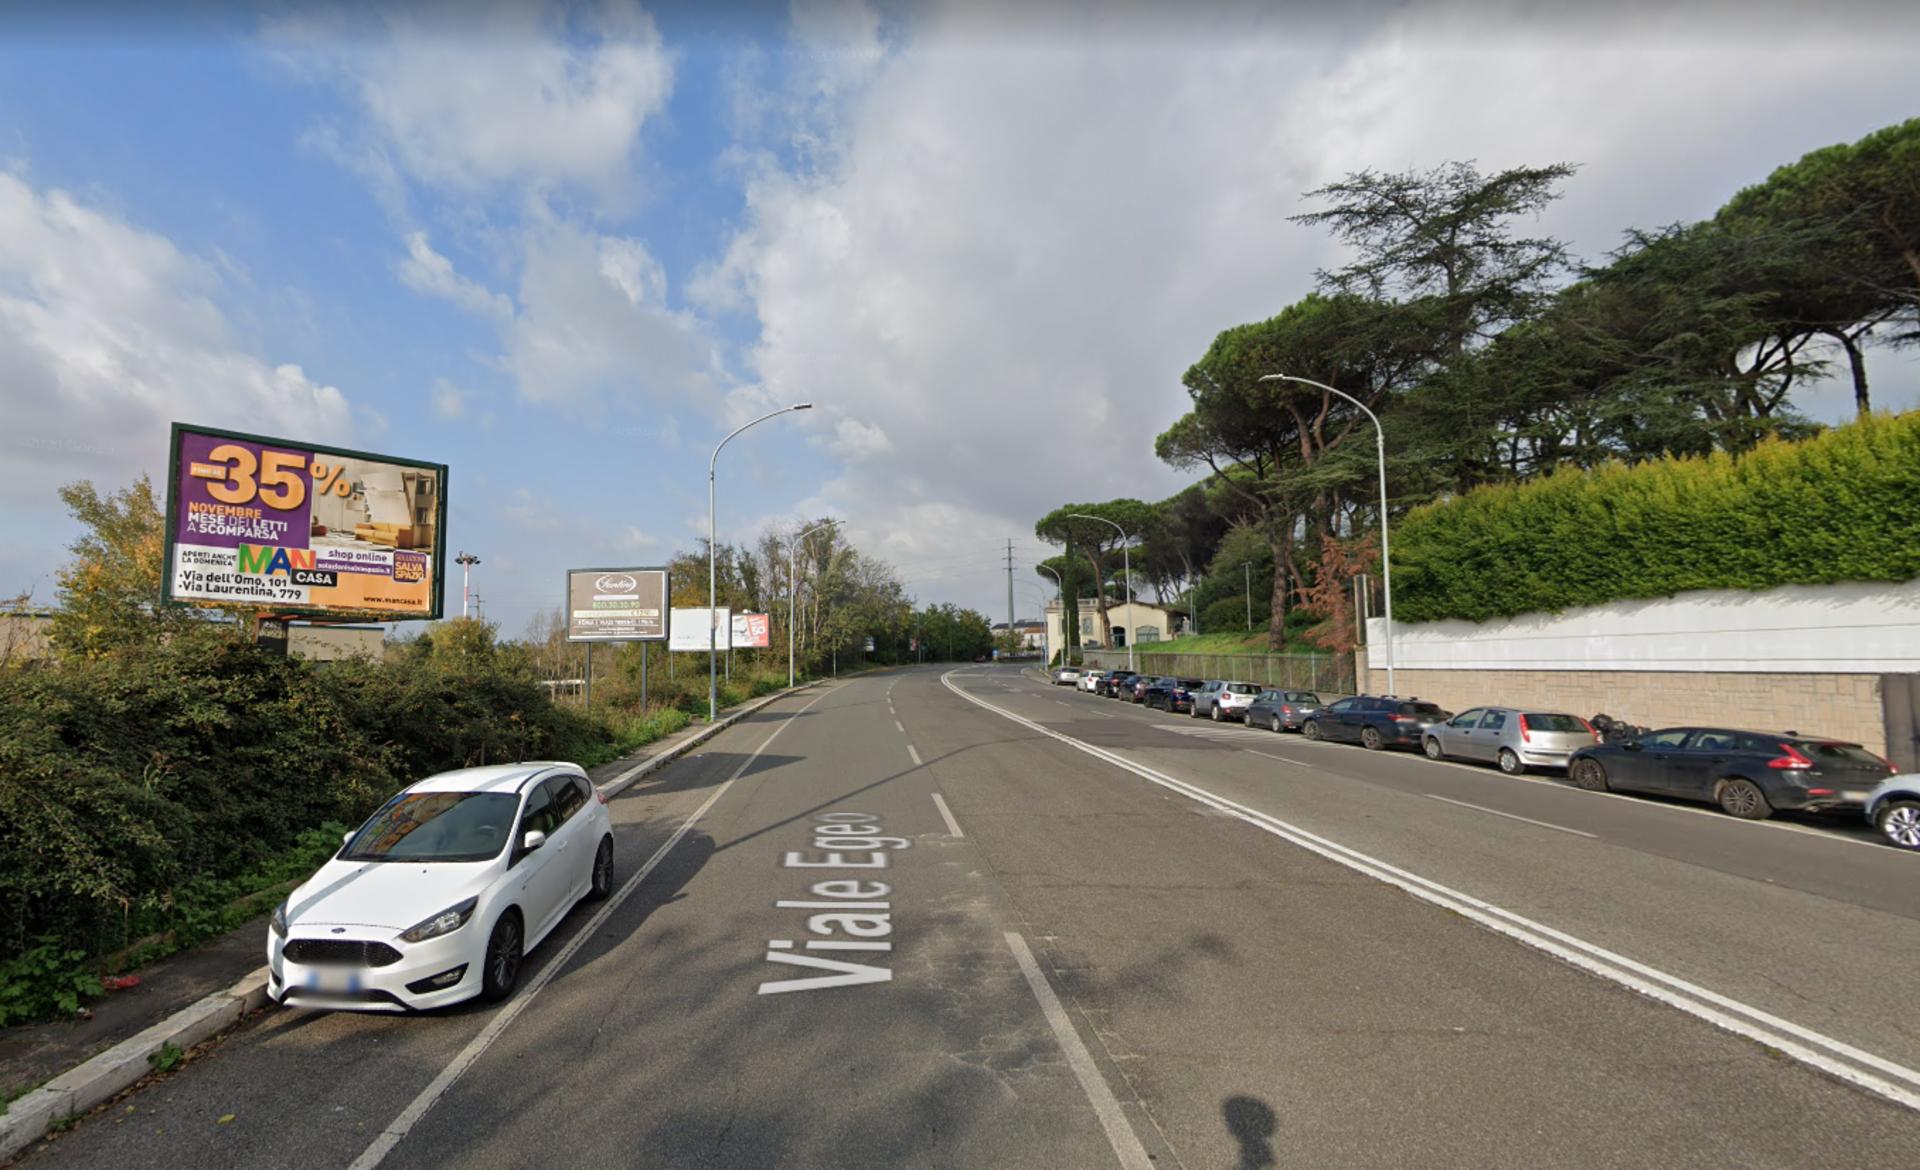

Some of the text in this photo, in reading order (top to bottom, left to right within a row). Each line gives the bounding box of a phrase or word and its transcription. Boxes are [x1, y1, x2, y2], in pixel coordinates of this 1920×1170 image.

[189, 501, 262, 519] NOVEMBRE
[188, 512, 288, 532] MESE DEI LETTI
[187, 522, 279, 540] A SCOMPARSA
[182, 550, 237, 561] APERTI ANCHE
[193, 558, 233, 566] DOMENICA
[239, 544, 317, 576] MAN
[328, 549, 388, 562] shop online
[395, 561, 424, 572] SALVA
[206, 572, 265, 587] dell'Omo,
[268, 578, 287, 587] 101
[296, 569, 332, 585] CASA
[206, 583, 276, 598] Laurentina,
[279, 589, 302, 600] 779
